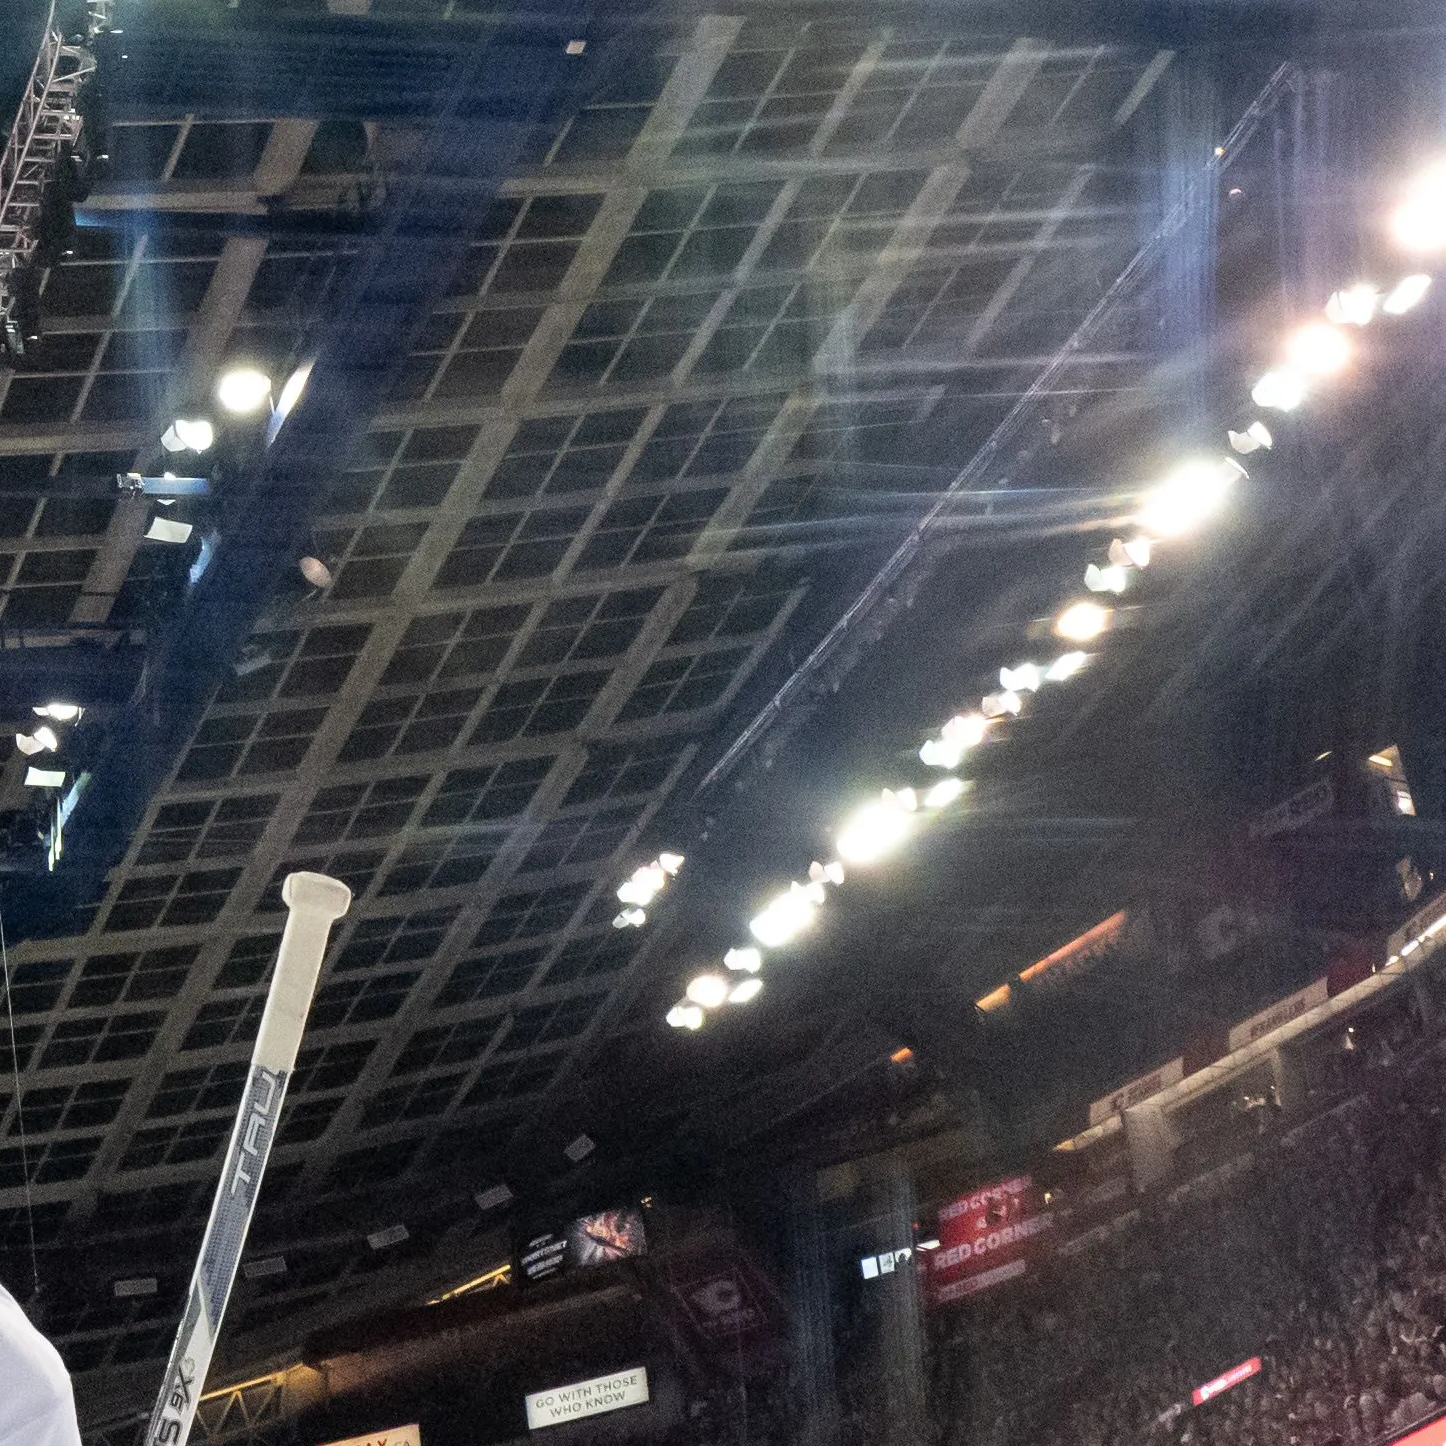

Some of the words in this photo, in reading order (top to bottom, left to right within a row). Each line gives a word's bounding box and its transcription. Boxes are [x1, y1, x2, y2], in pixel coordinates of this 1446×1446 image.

[536, 1394, 555, 1409] GO
[558, 1385, 592, 1402] WITH
[595, 1374, 638, 1393] THOSE
[549, 1403, 583, 1419] WHO
[586, 1390, 627, 1409] KNOW
